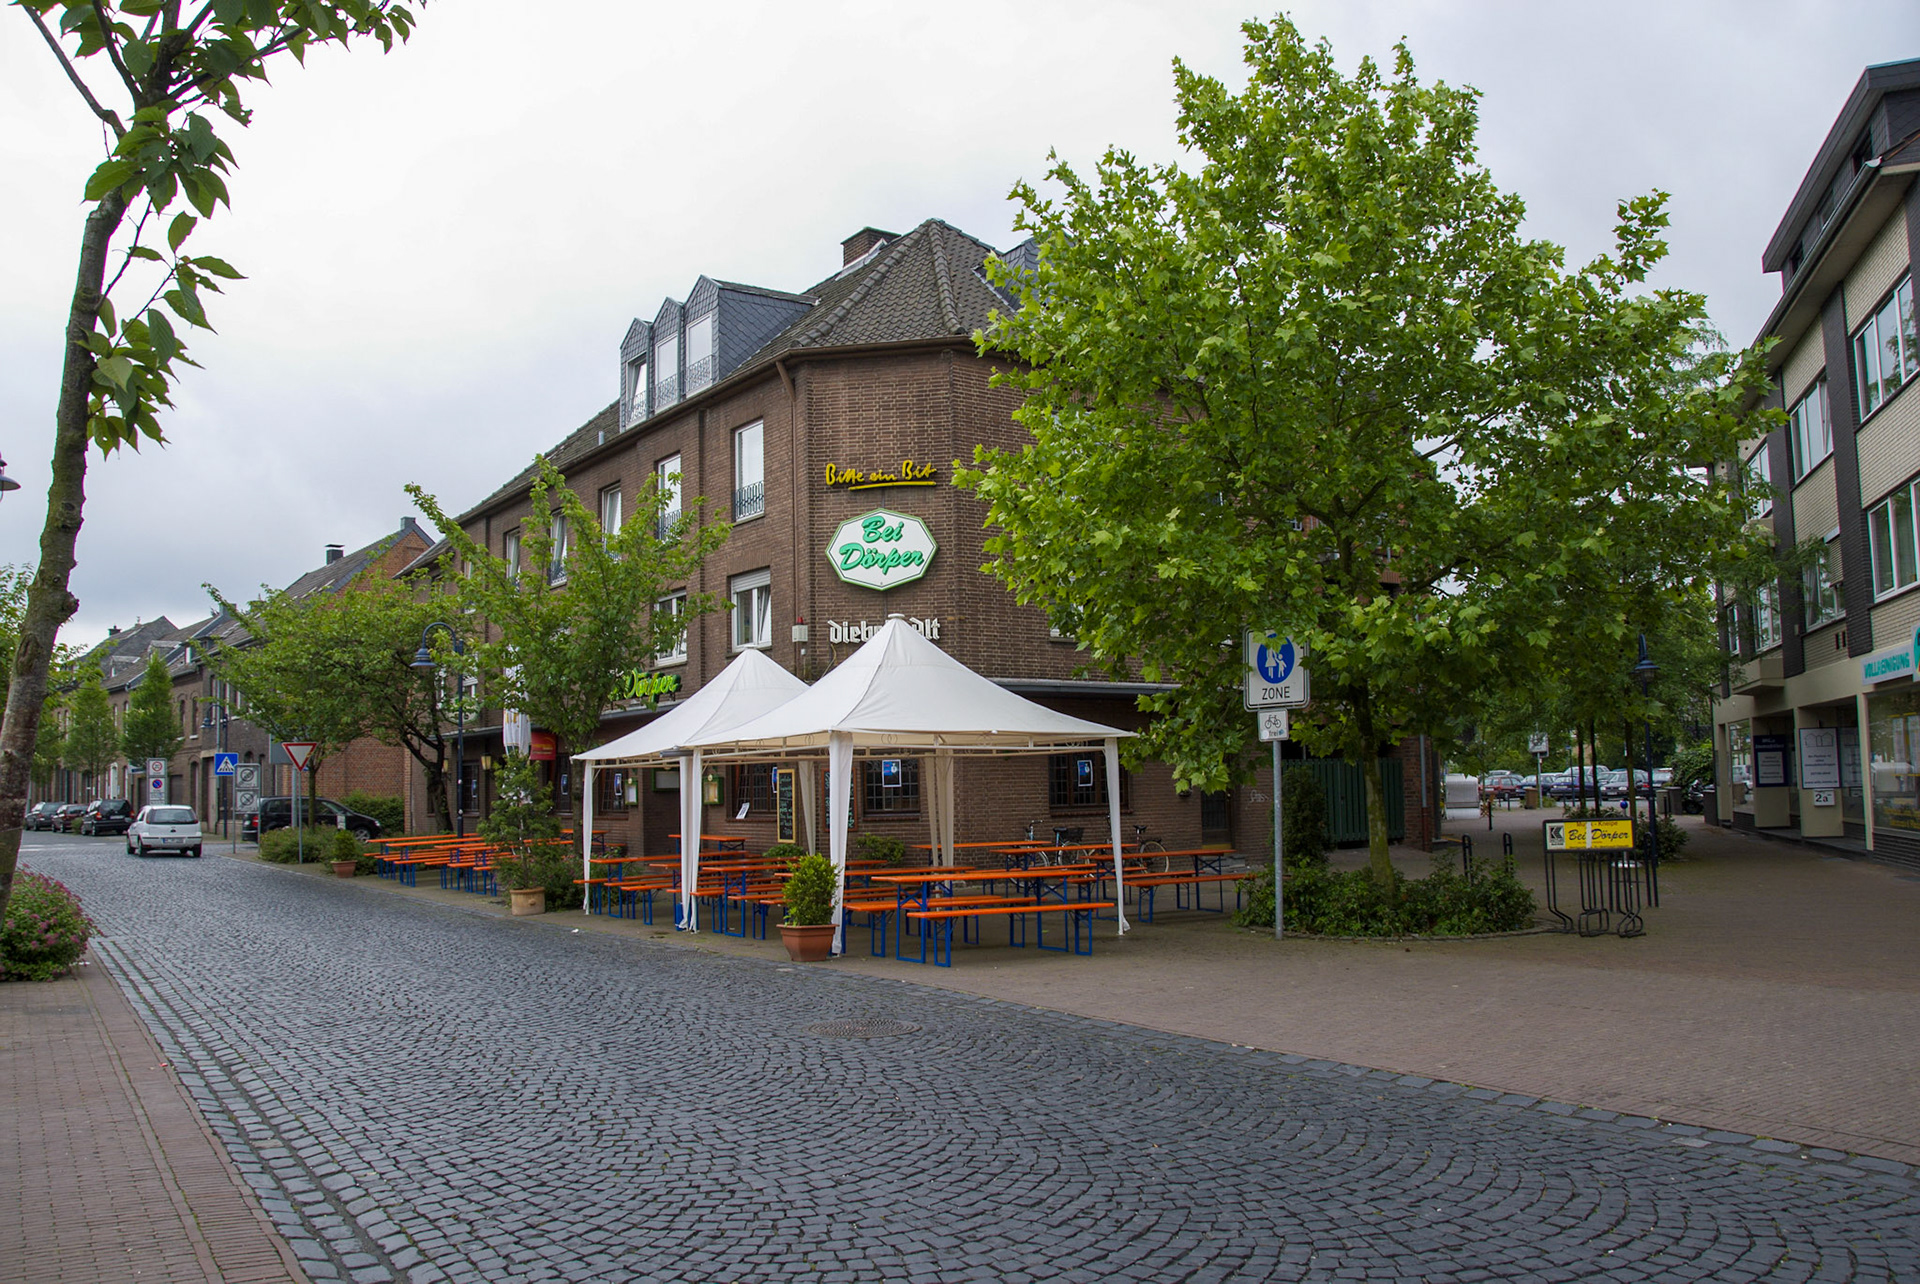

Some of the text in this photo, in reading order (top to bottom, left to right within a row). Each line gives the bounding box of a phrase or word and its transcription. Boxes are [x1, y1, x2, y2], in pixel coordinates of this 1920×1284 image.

[825, 459, 937, 486] Bitte ein Bit
[861, 515, 905, 543] Bei
[838, 542, 925, 576] Dörper
[1262, 686, 1290, 700] ZONE
[1268, 729, 1279, 737] frei
[1815, 793, 1828, 803] 2a
[1568, 828, 1629, 842] Bei Dörper
